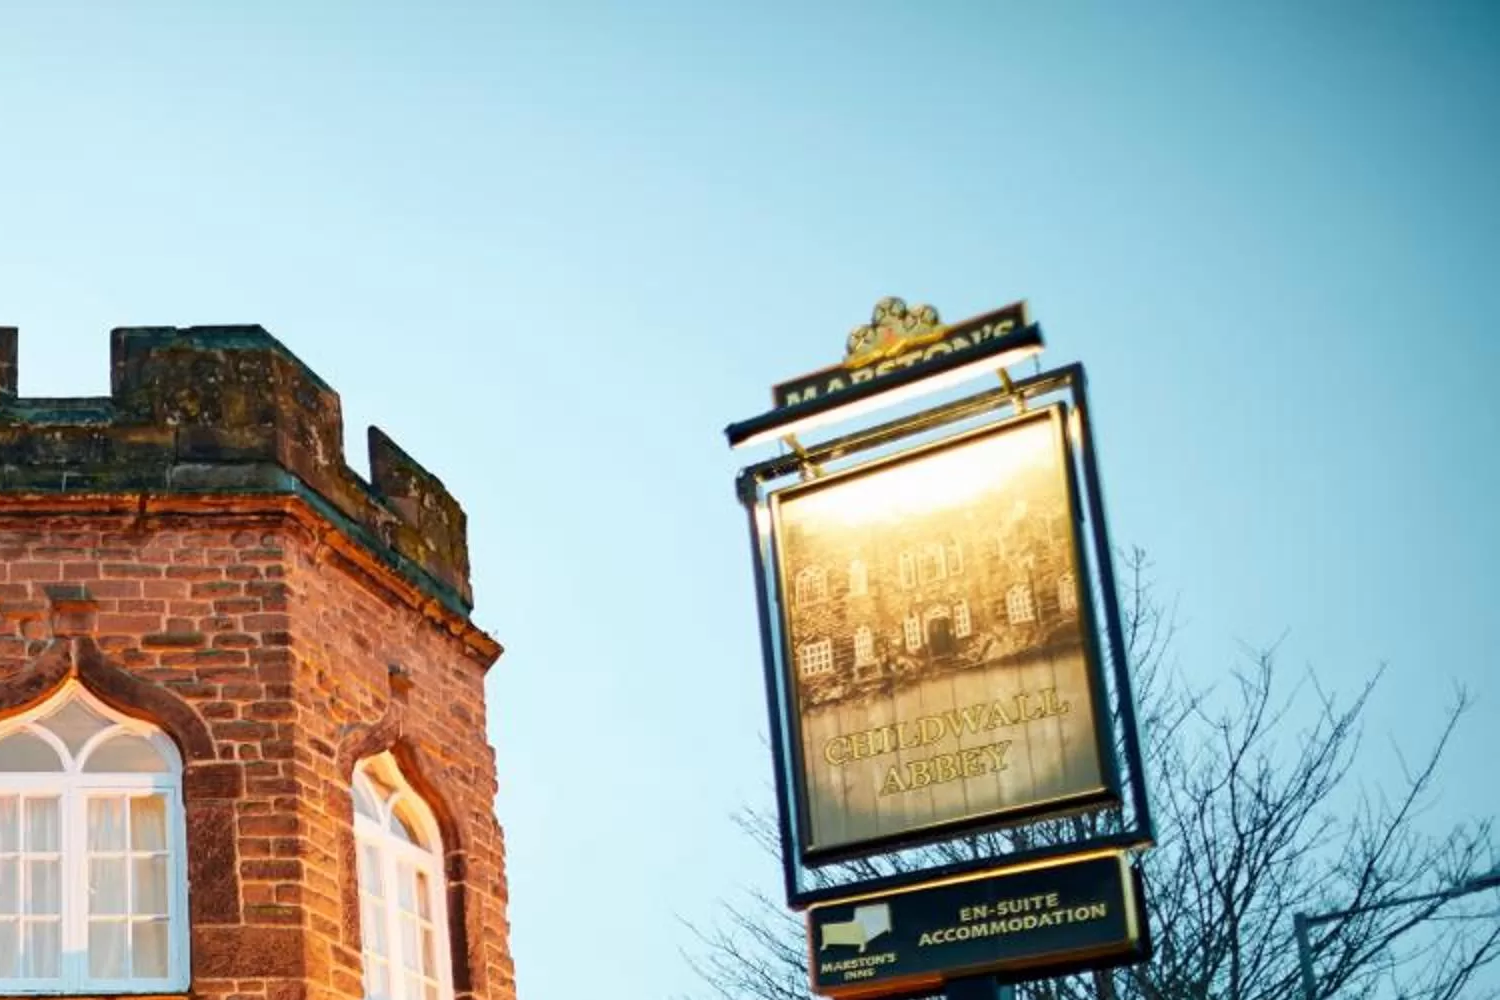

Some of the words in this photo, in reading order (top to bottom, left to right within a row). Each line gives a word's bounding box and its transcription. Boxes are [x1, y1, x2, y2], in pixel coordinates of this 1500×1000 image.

[824, 687, 1070, 766] CHILDWALL
[879, 739, 1012, 796] ABBEY
[918, 903, 1107, 947] ACCOMMODATION
[959, 892, 1060, 923] EN-SUITE
